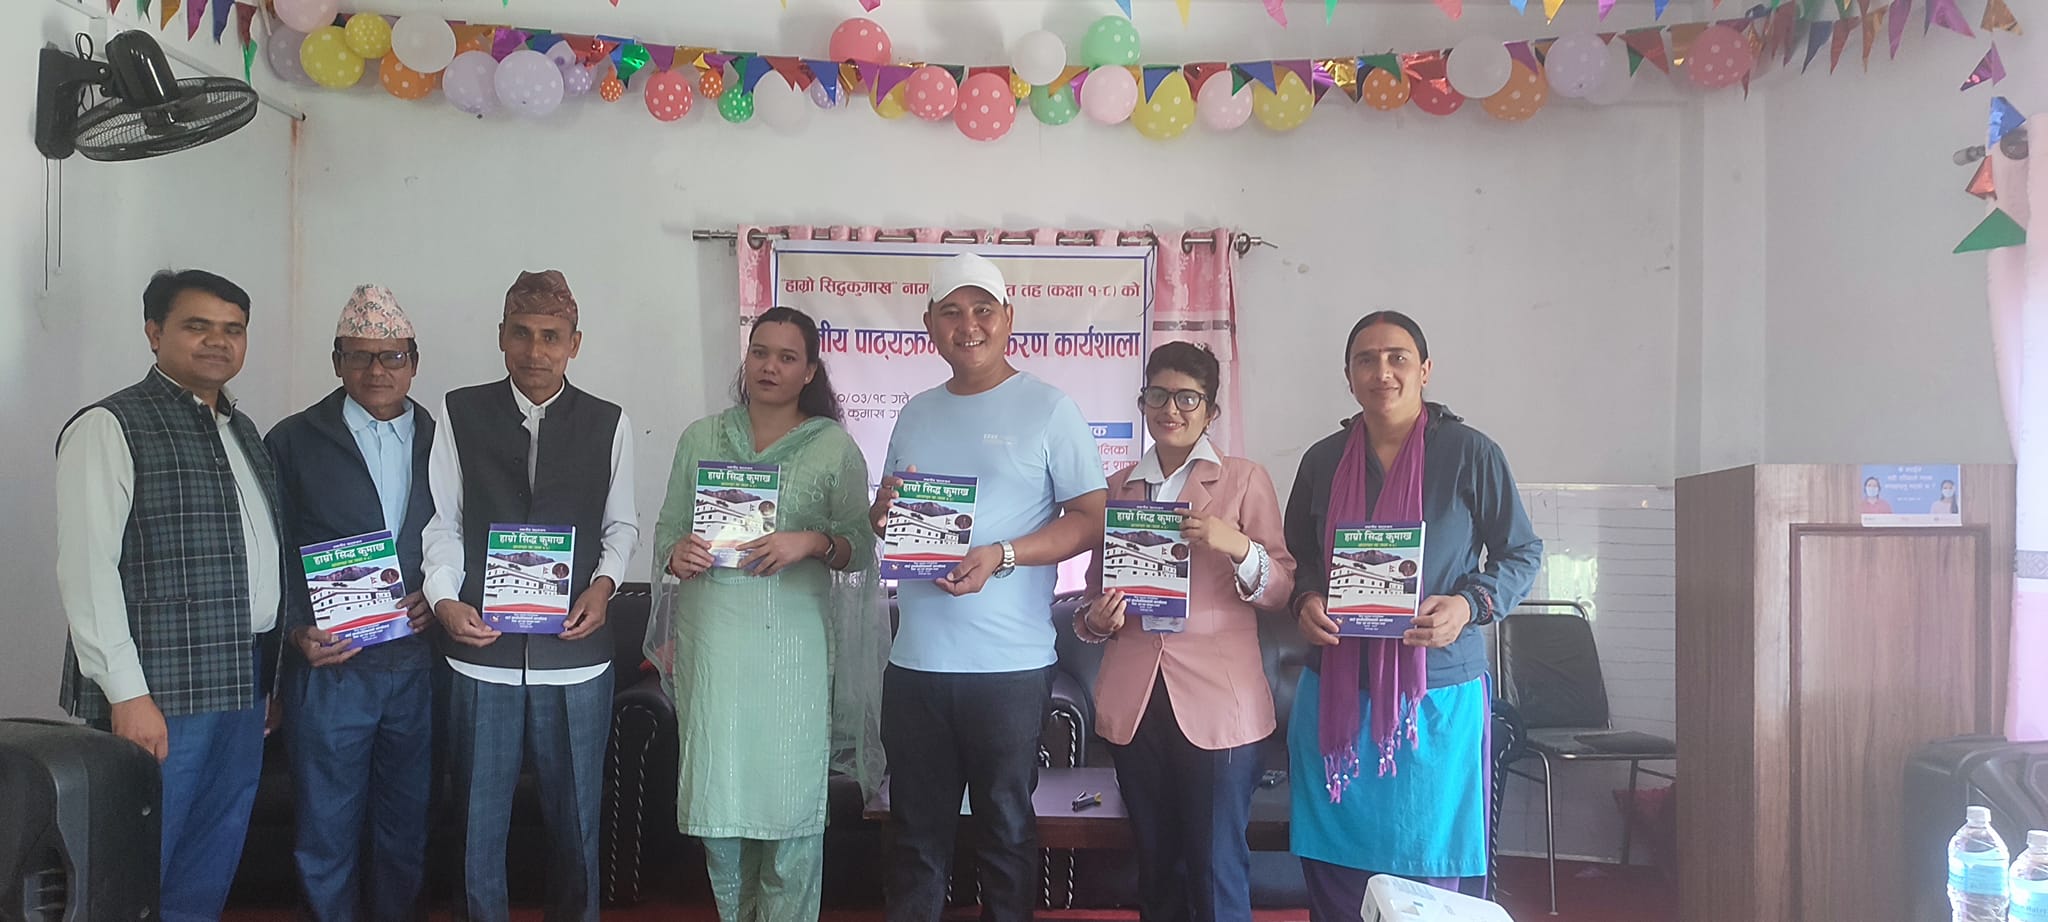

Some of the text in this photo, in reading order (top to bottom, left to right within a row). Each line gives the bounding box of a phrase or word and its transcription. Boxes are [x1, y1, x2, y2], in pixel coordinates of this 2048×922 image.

[1021, 284, 1042, 298] तह
[1047, 284, 1083, 299] (कक्षा
[1121, 281, 1141, 297] को
[1055, 325, 1141, 358] कार्यशाला
